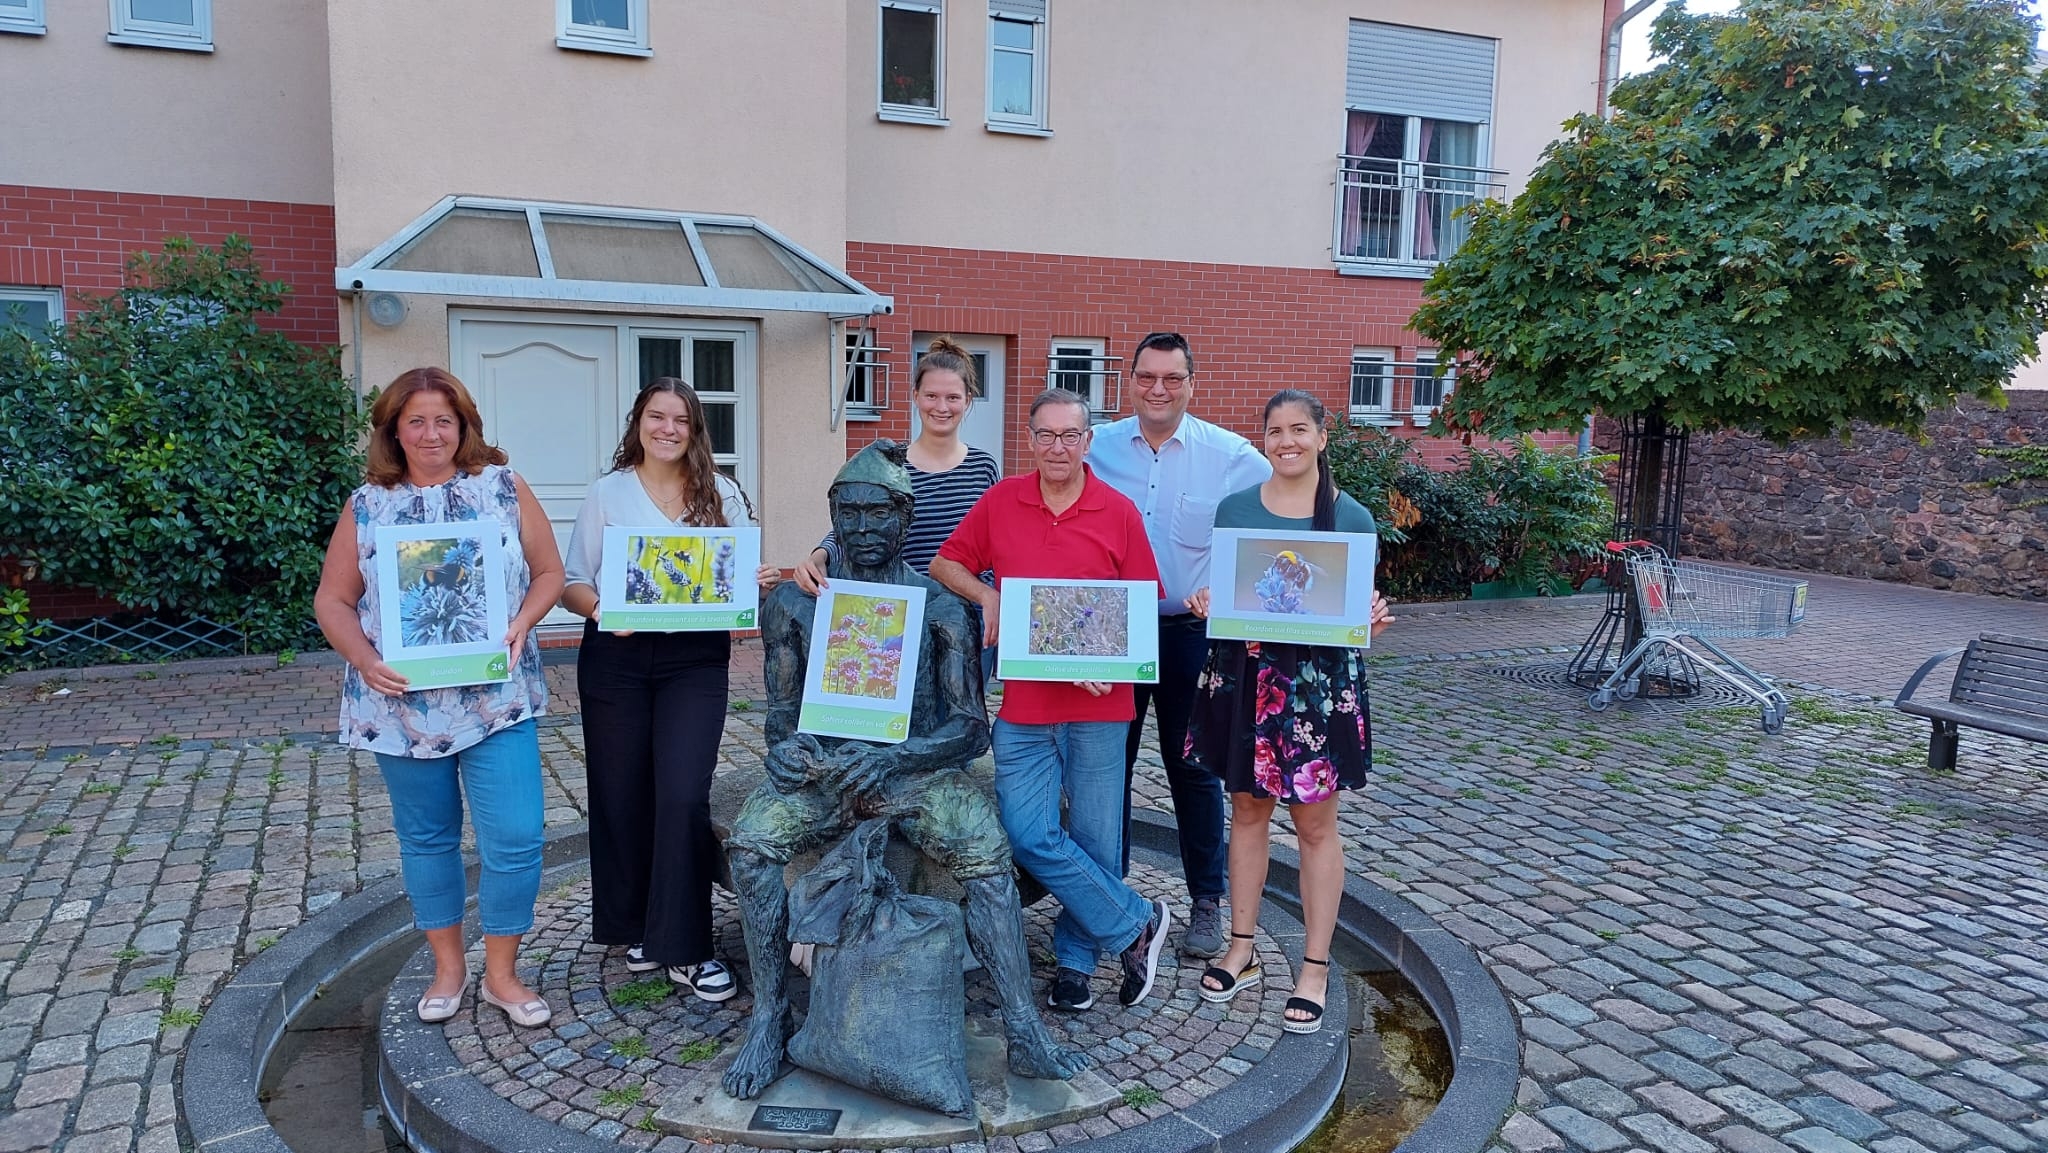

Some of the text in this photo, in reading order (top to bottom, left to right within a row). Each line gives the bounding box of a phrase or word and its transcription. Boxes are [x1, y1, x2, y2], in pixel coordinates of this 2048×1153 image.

[741, 612, 752, 620] 28
[1352, 628, 1365, 637] 29
[491, 662, 504, 671] 26
[1142, 665, 1153, 673] 30
[891, 722, 904, 730] 27
